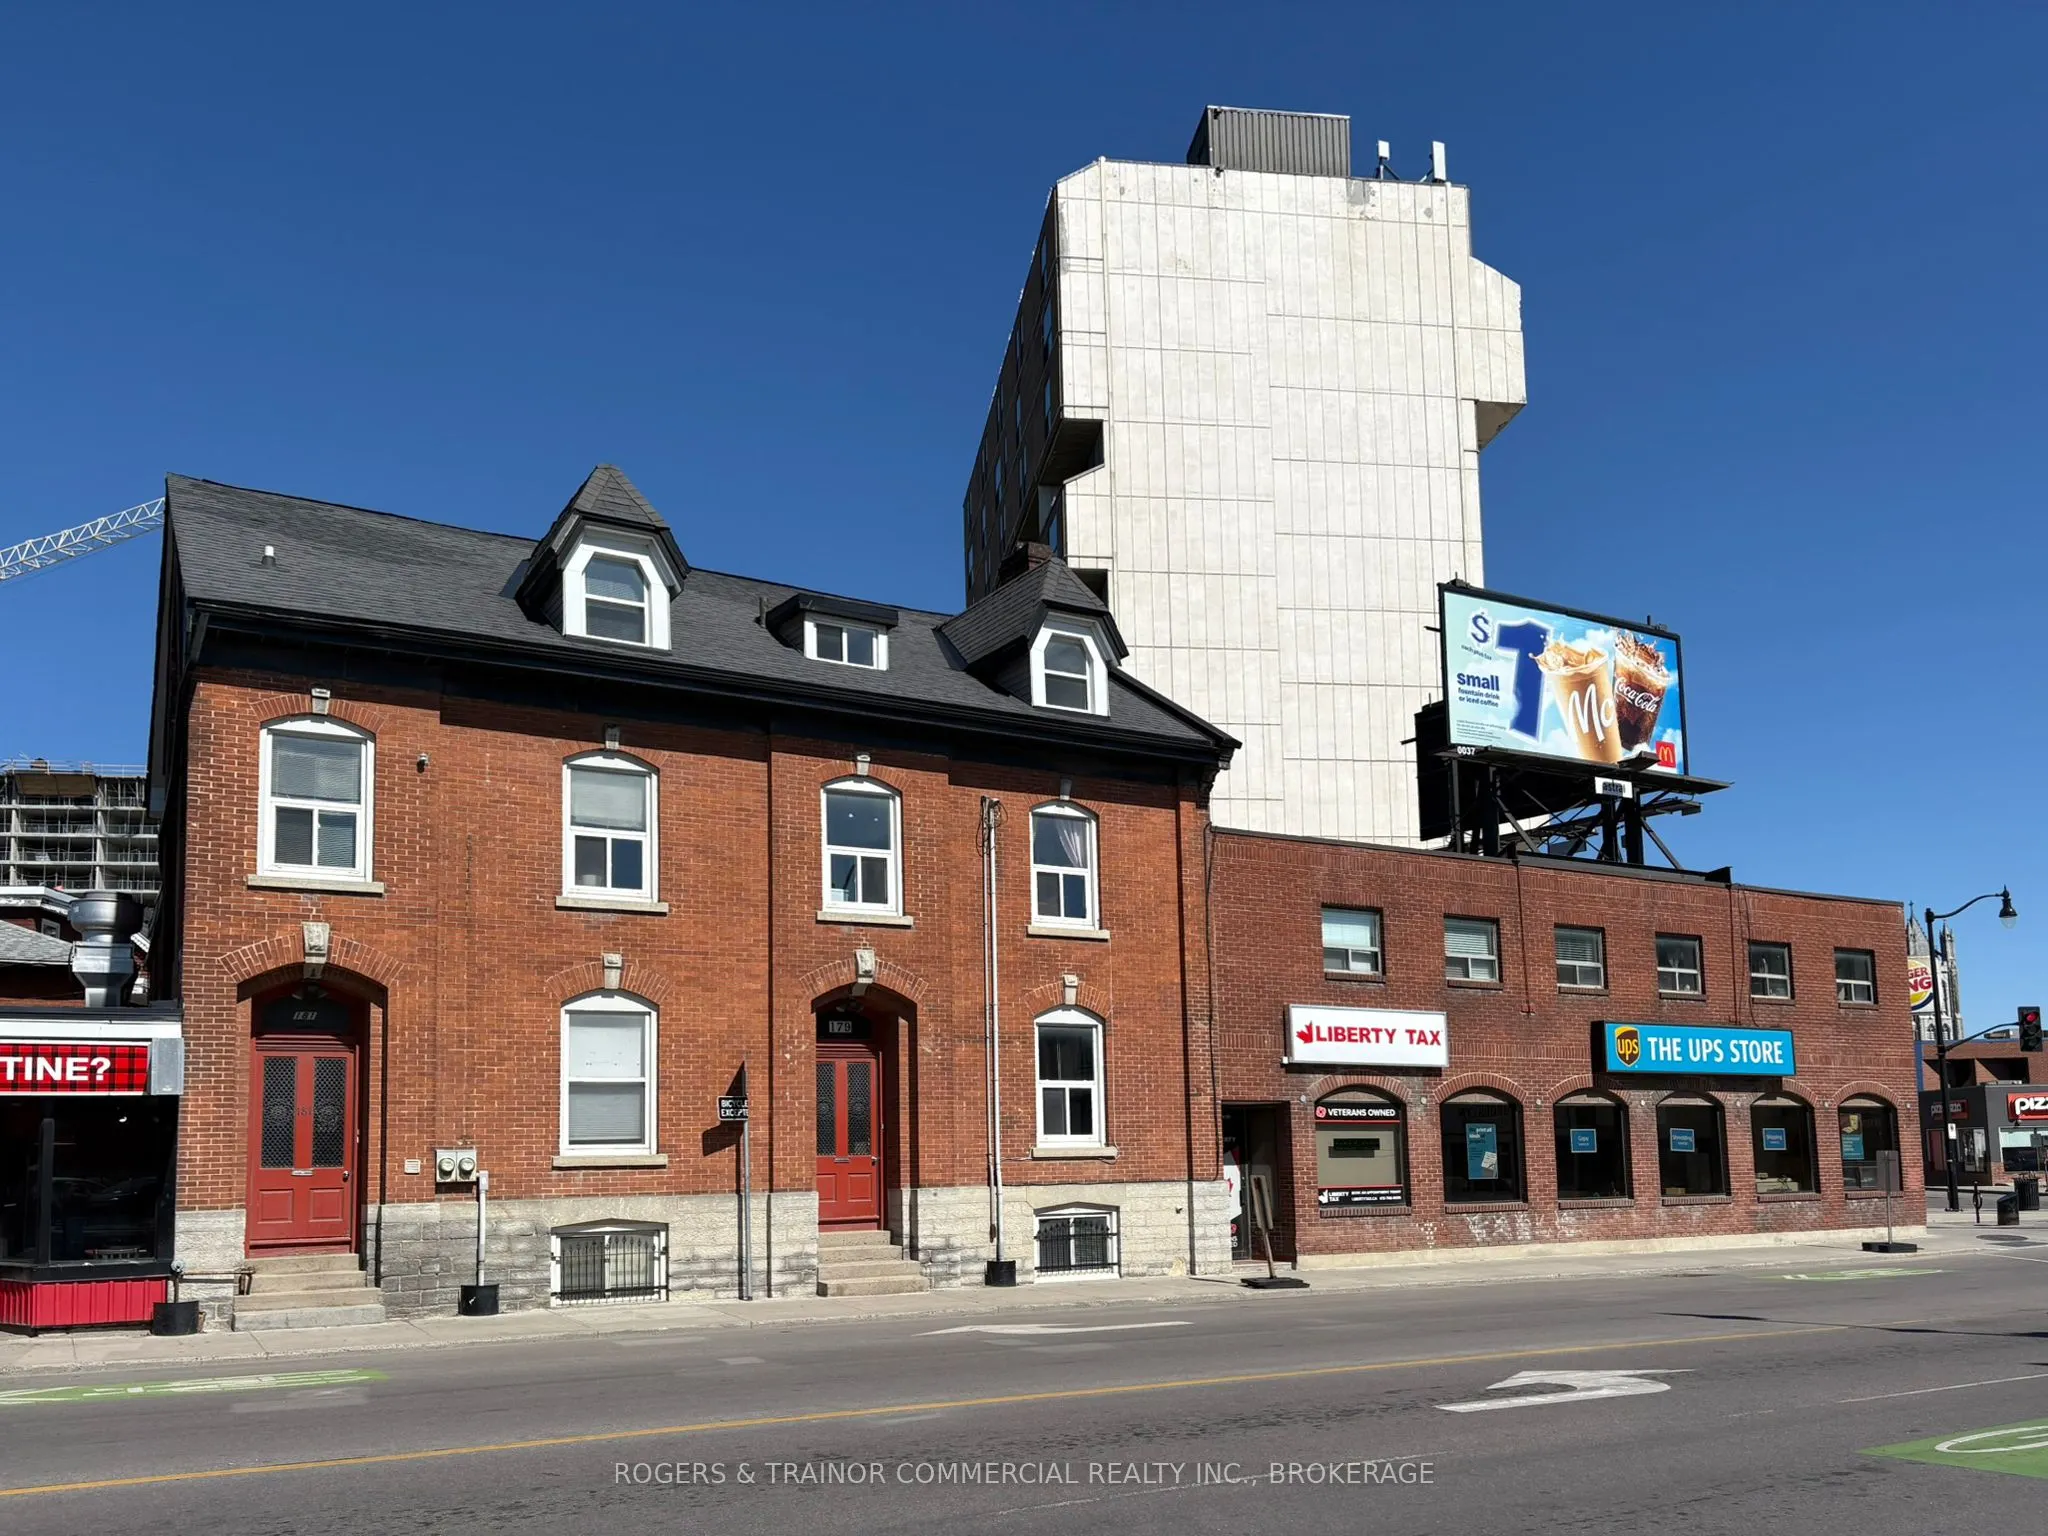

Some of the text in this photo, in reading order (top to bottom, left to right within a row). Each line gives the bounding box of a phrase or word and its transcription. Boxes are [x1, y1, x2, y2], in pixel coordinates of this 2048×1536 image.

[1457, 673, 1499, 691] small
[1458, 687, 1500, 701] fountain drink
[1466, 695, 1479, 704] iced
[1480, 698, 1499, 707] coffee
[1457, 746, 1476, 755] 0037
[1316, 1026, 1441, 1046] LIBERTY TAX
[1617, 1039, 1639, 1061] ups
[1647, 1037, 1784, 1064] THE UPS STORE
[0, 1056, 111, 1081] TINE?
[1328, 1108, 1396, 1117] VETERANS OWNED
